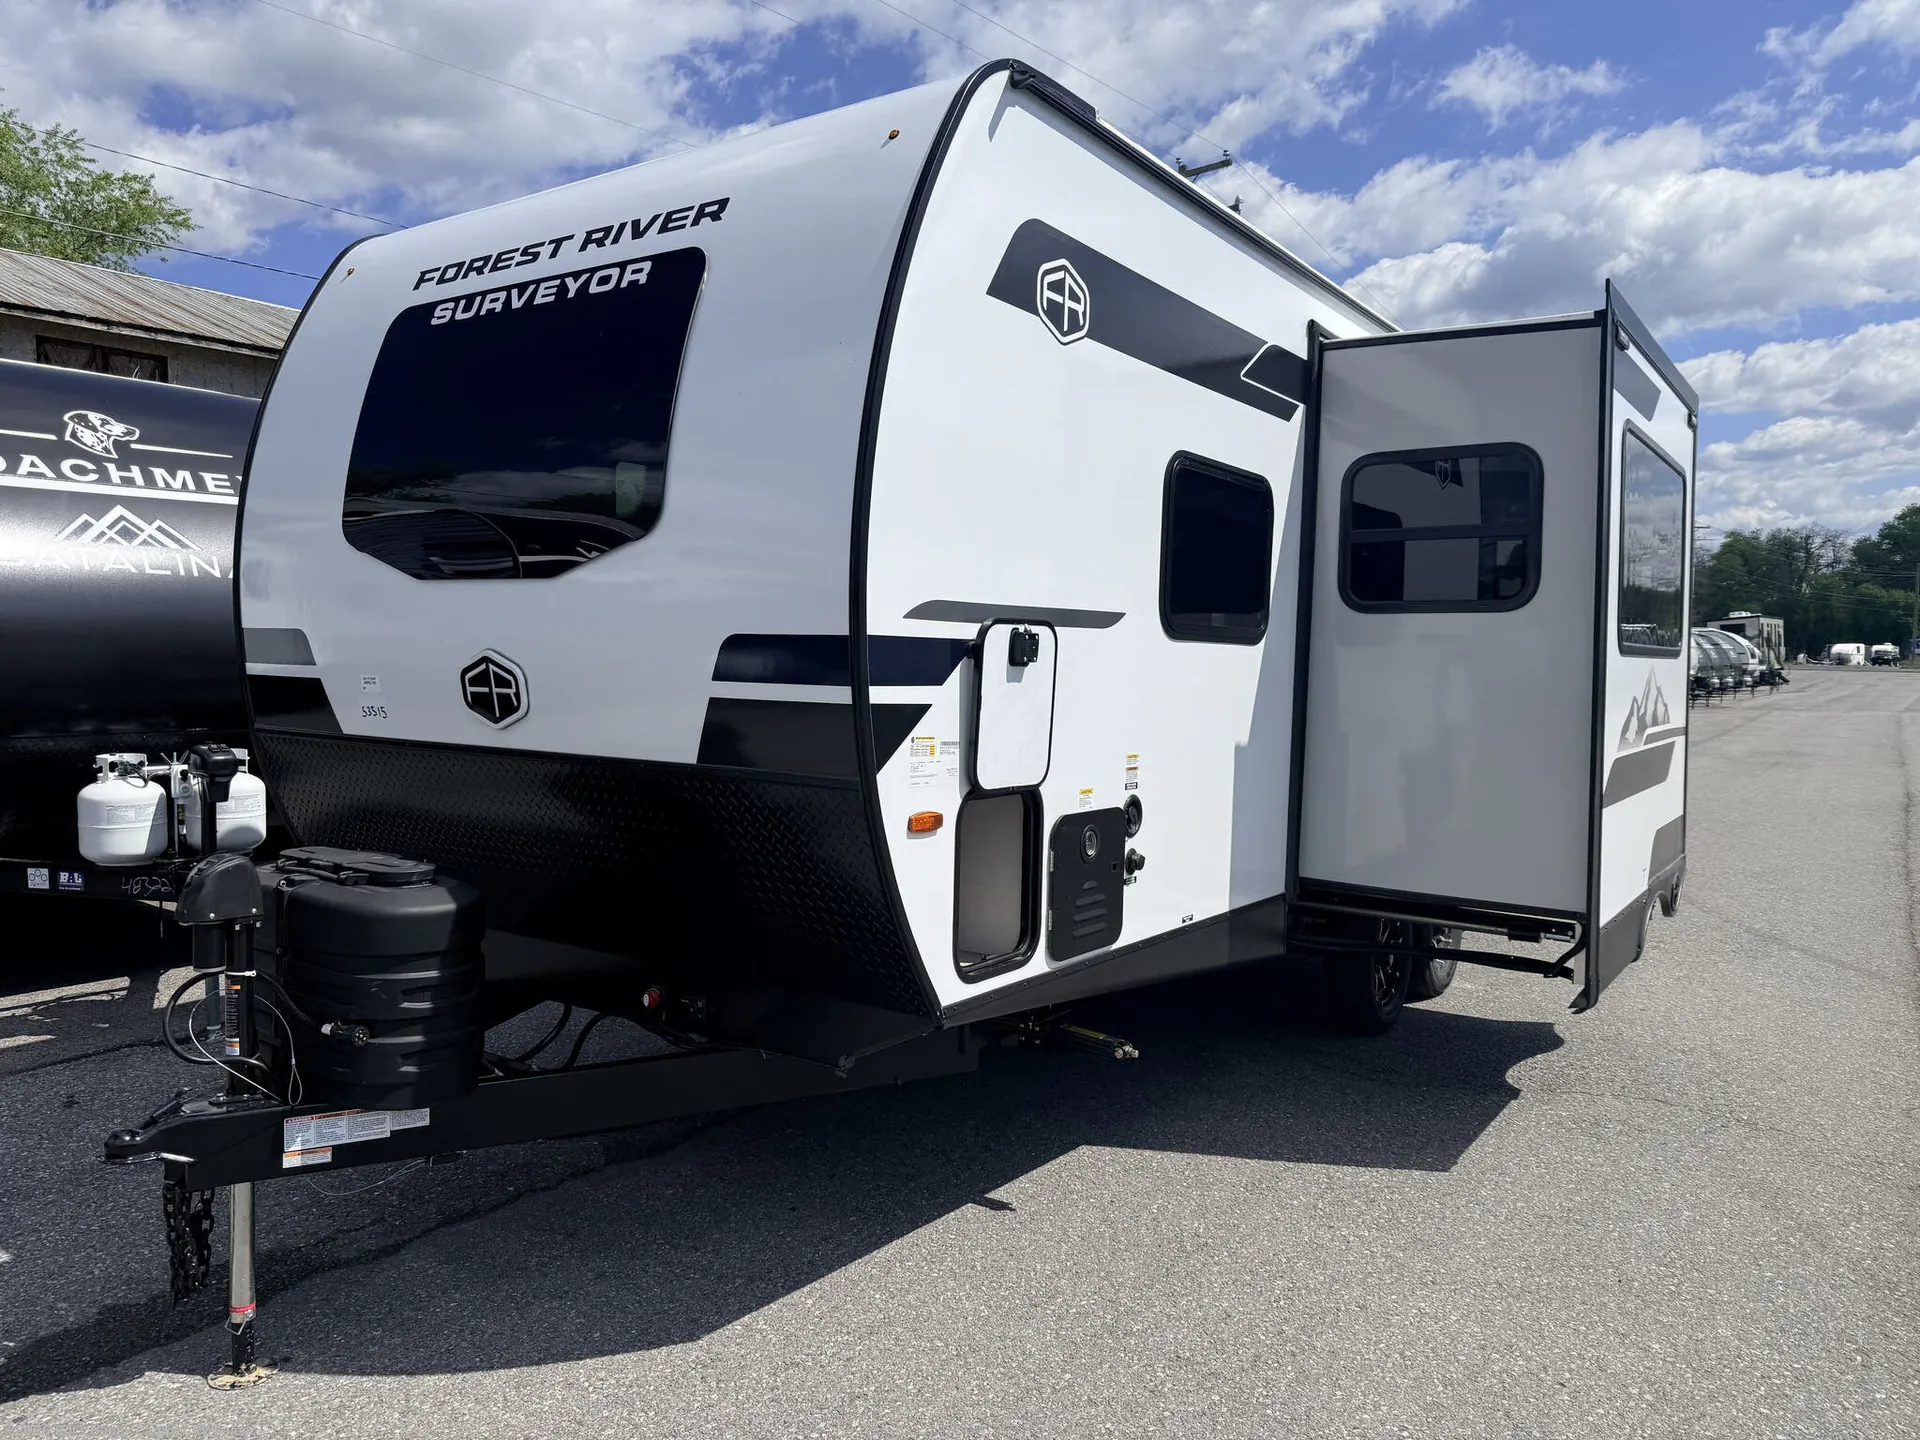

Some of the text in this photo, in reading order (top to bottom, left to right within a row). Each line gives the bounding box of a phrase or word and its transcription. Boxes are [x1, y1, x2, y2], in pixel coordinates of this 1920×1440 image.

[412, 197, 731, 291] FOREST RIVER
[430, 260, 653, 326] SURVEYOR
[0, 453, 242, 494] ACHME
[0, 545, 233, 579] ATALIN
[361, 704, 388, 719] 53515
